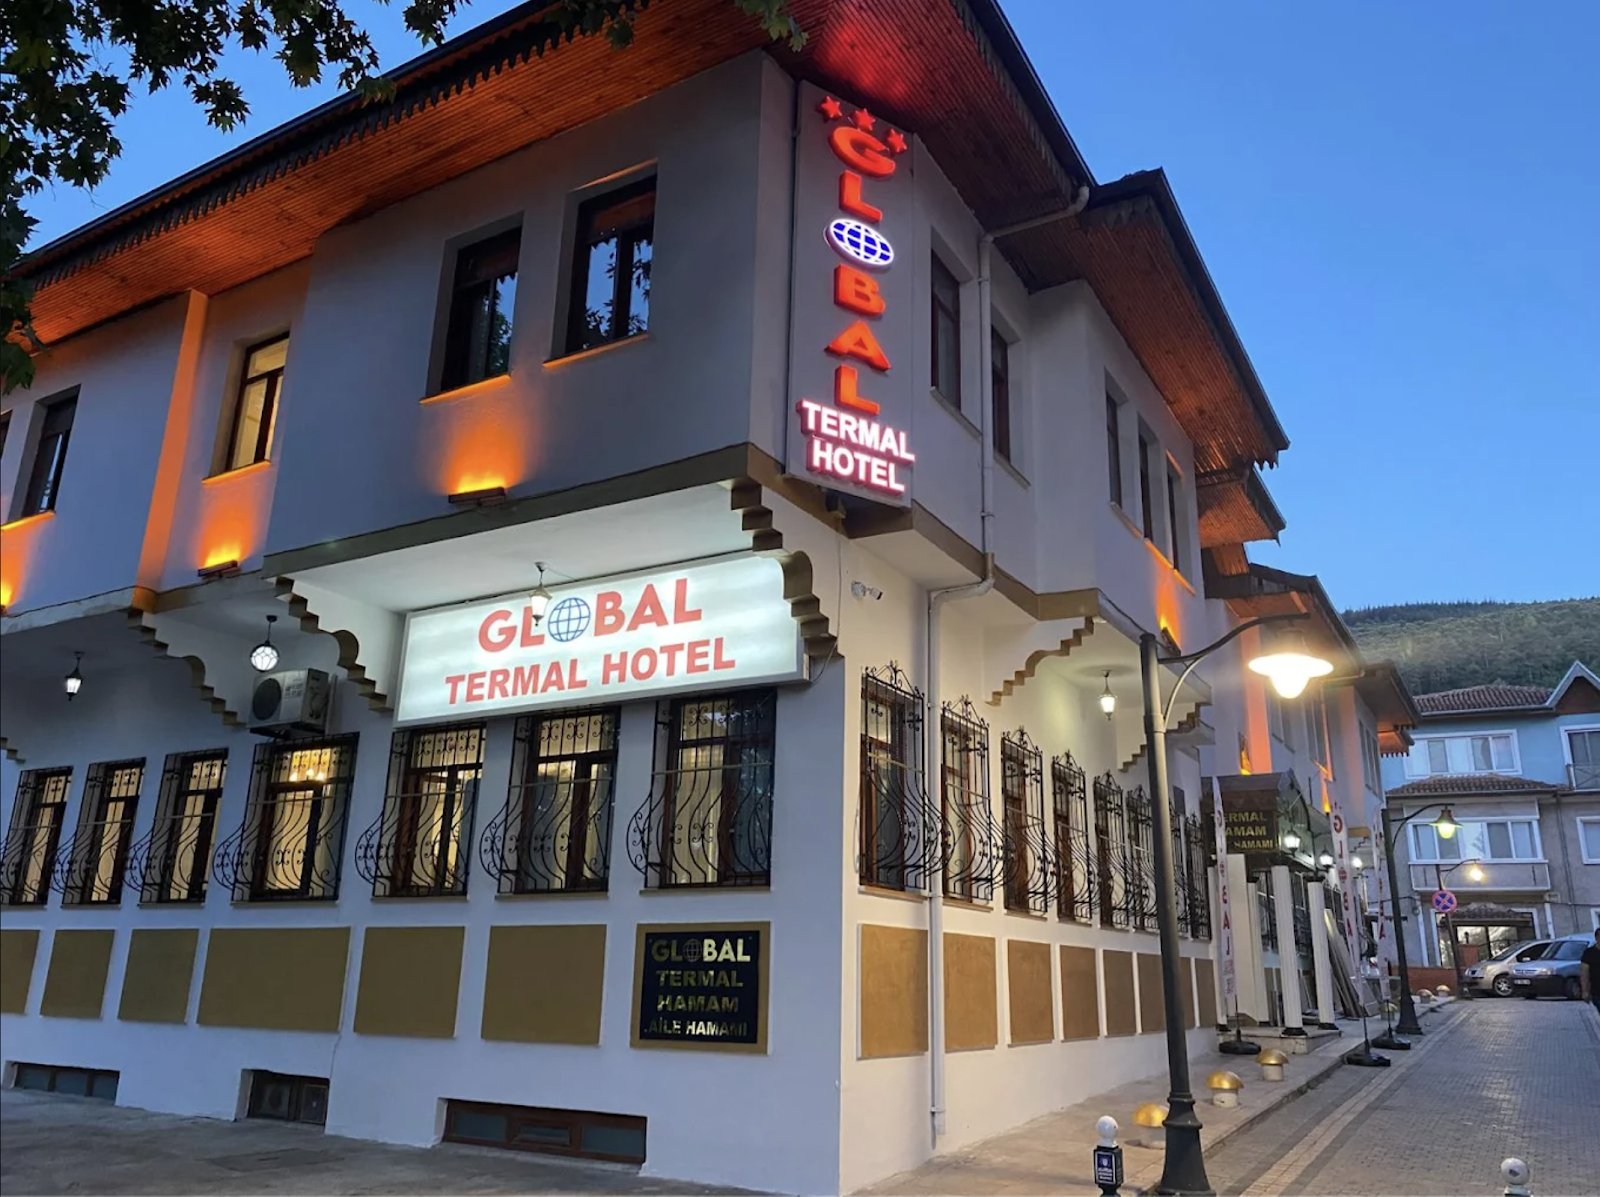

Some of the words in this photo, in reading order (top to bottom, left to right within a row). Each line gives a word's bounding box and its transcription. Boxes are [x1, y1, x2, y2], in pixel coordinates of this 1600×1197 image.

[799, 400, 916, 462] TERMAL
[808, 438, 906, 493] HOTEL
[445, 658, 588, 705] TERMAL
[601, 637, 736, 685] HOTEL
[1210, 811, 1267, 822] RMAL
[1225, 825, 1267, 836] AMAM
[655, 969, 744, 987] TERMAL
[656, 995, 739, 1013] HAMAM
